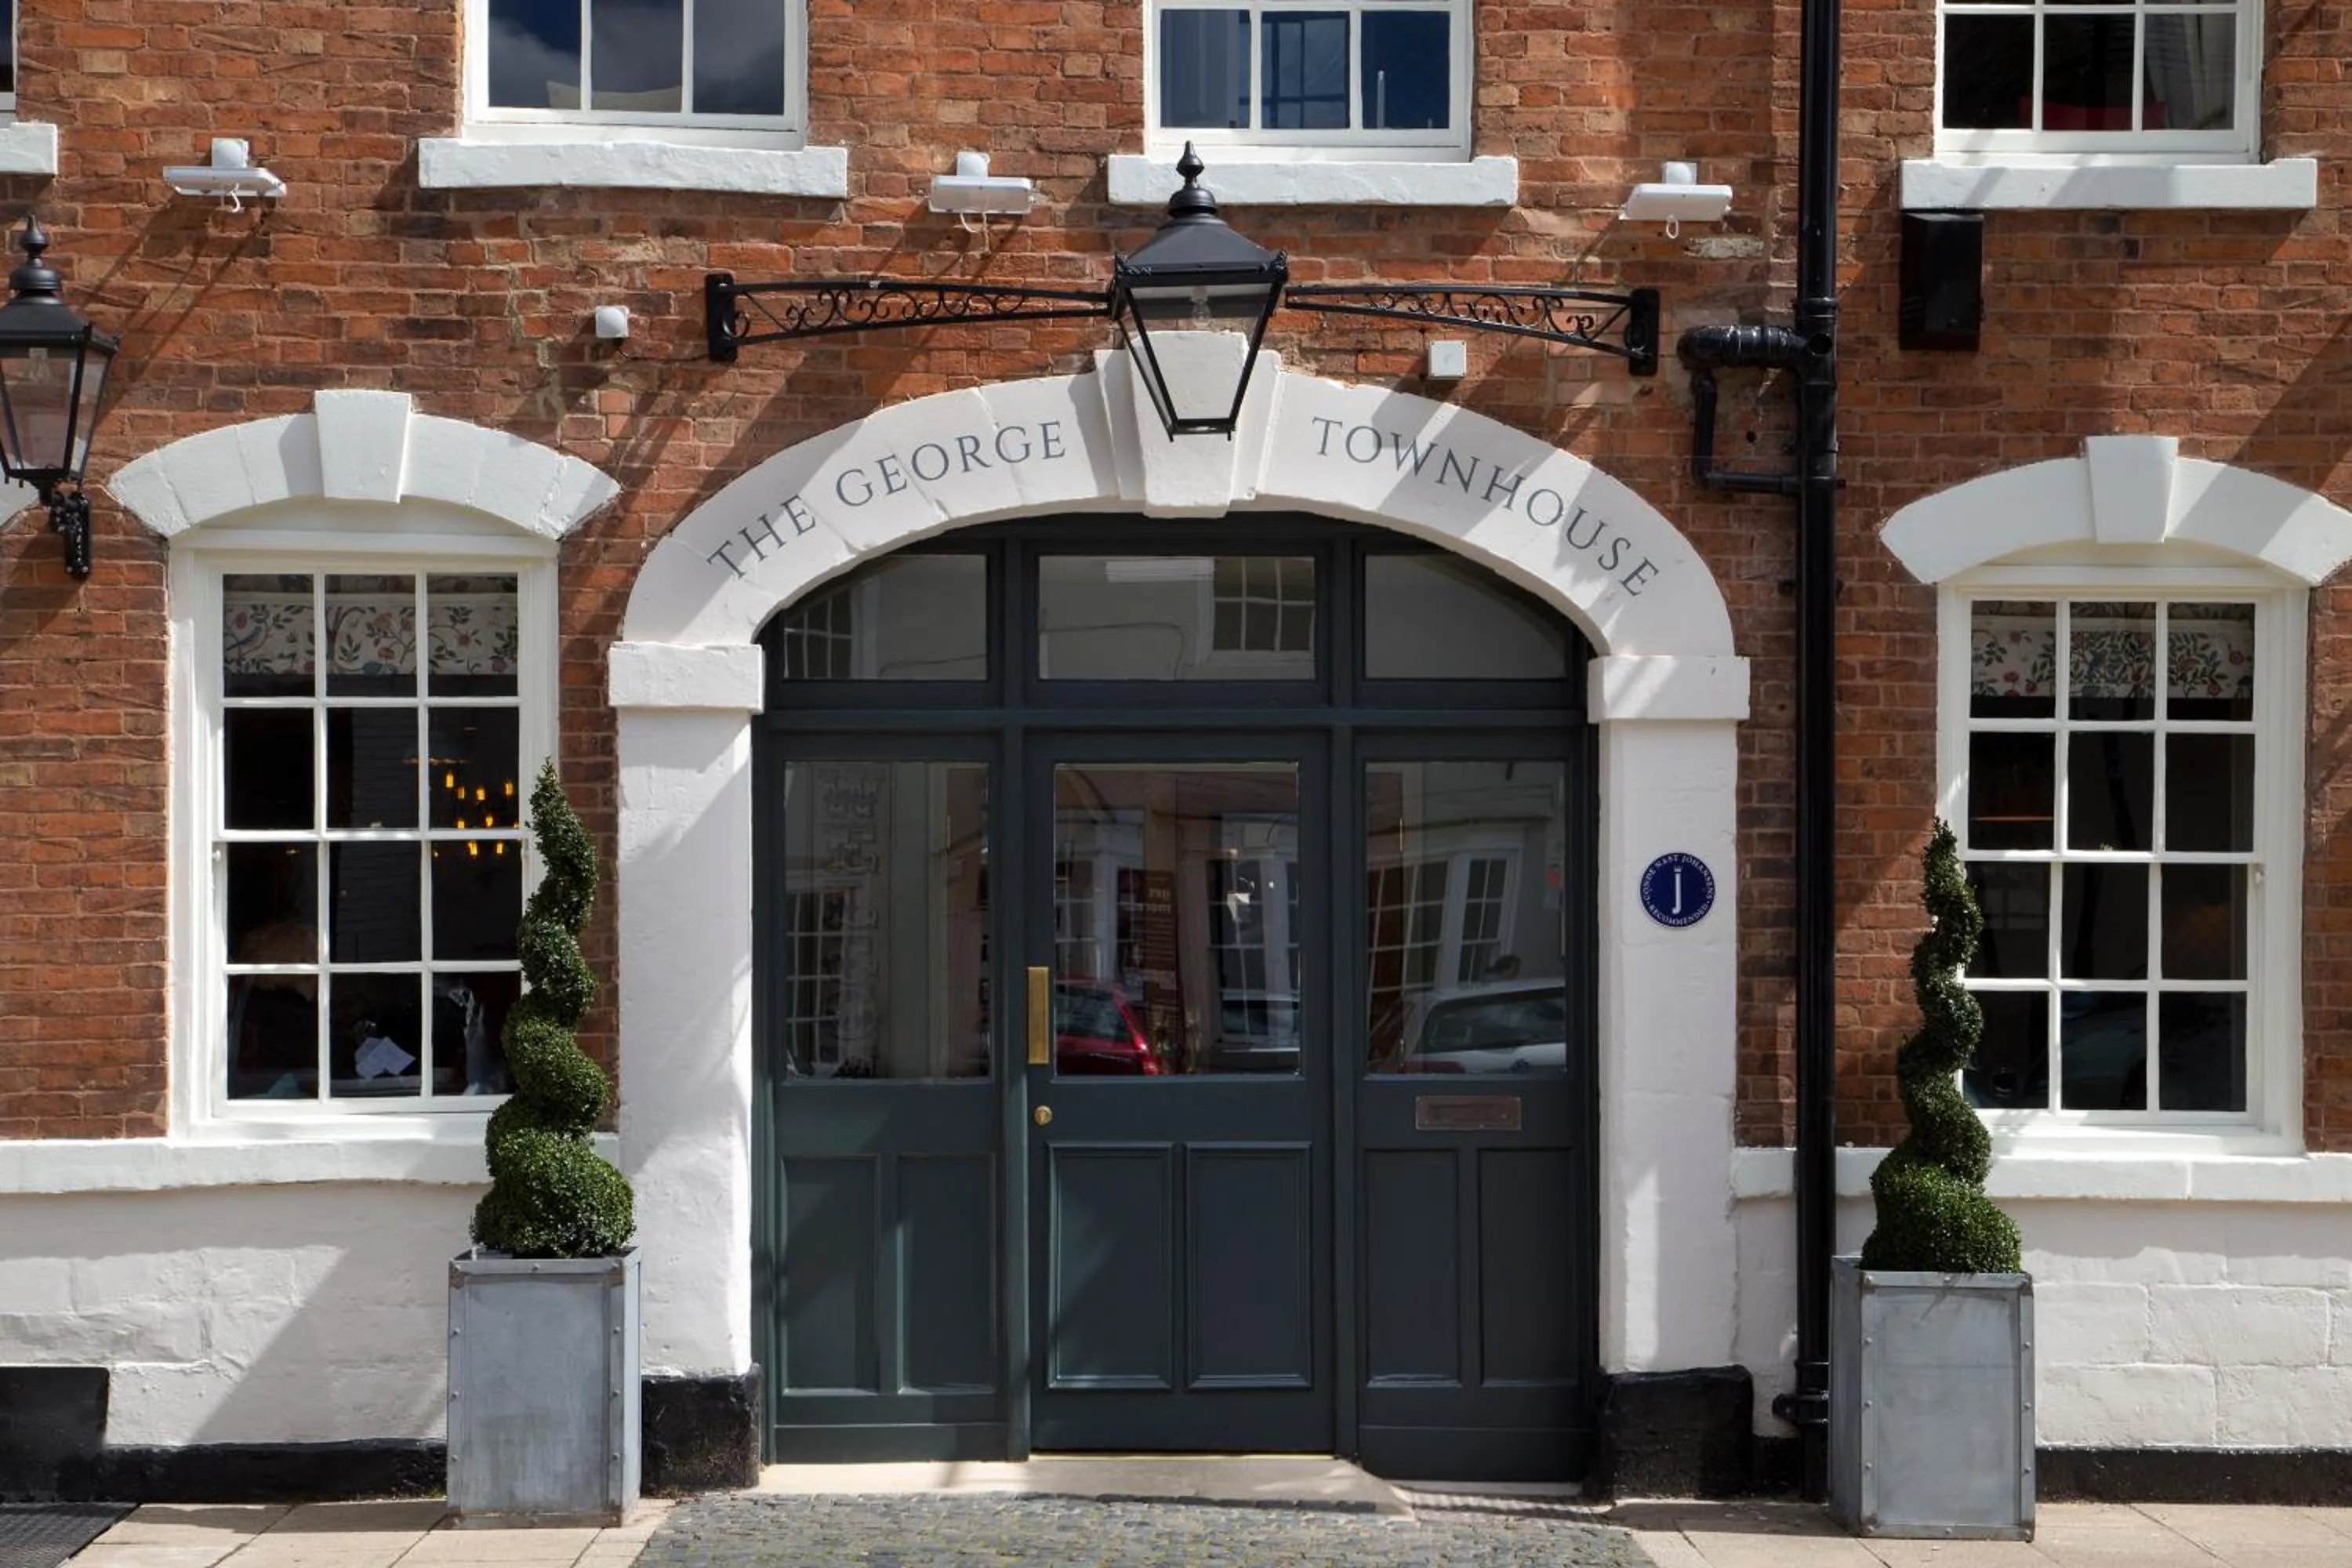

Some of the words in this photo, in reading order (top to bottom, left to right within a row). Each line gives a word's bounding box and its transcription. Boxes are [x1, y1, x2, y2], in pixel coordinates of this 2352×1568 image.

[707, 495, 816, 579] THE
[835, 421, 1066, 507] GEORGE
[1312, 416, 1659, 597] TOWNHOUSE
[1655, 855, 1679, 866] NAST
[1649, 903, 1708, 925] RECOMMENDED
